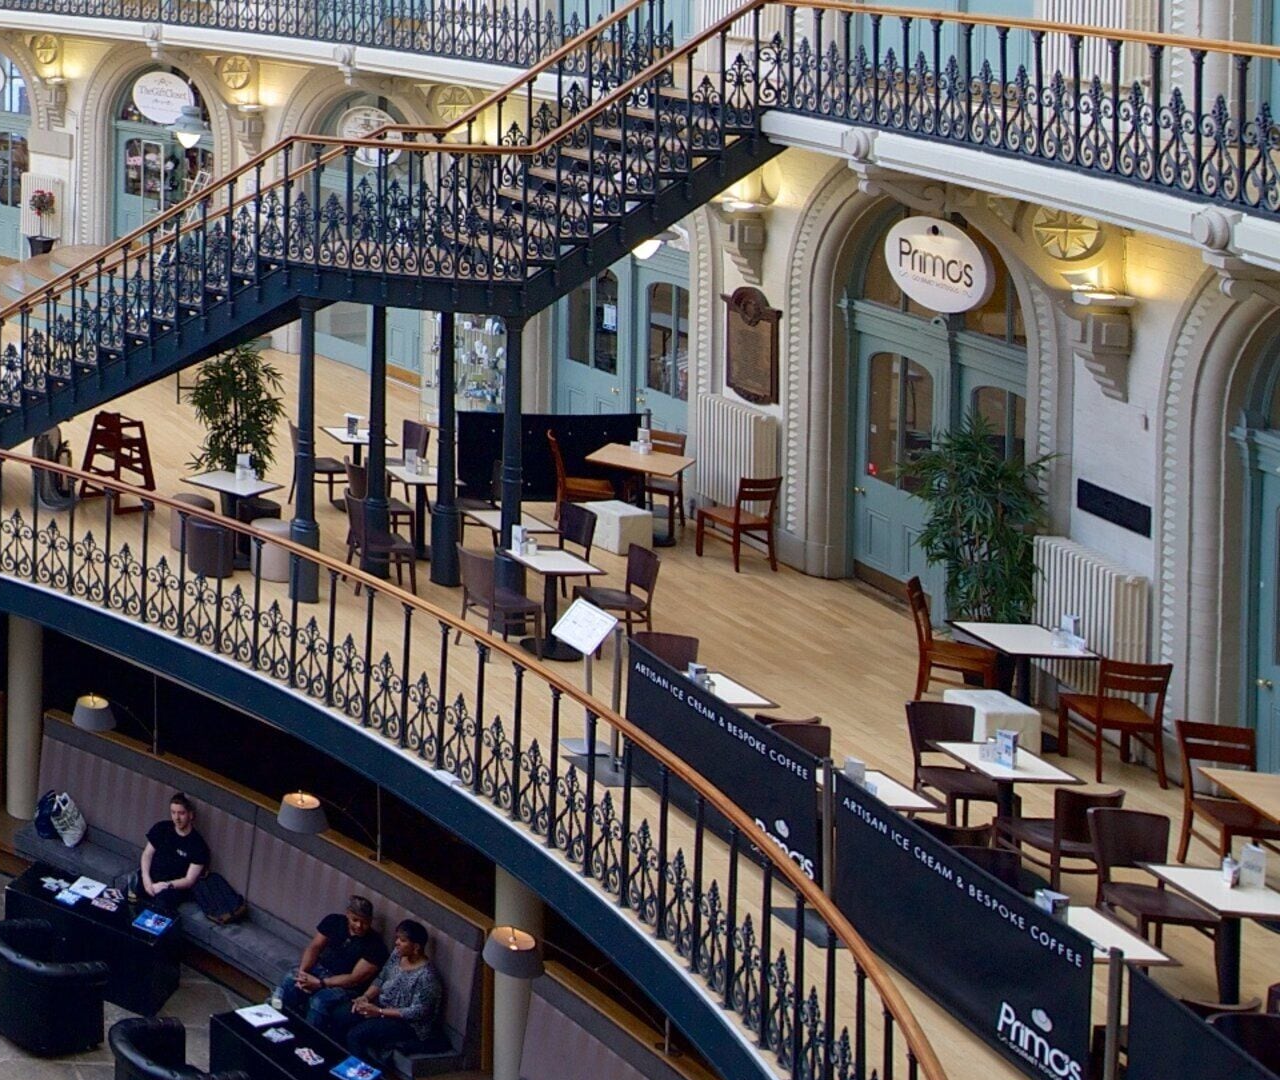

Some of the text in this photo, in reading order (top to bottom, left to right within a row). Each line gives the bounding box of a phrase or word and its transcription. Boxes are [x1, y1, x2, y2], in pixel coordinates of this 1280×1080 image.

[635, 661, 809, 780] ARTISAN ICE CREAM & BESPOKE COFFEE
[842, 796, 1082, 968] ARTISAN ICE CREAM & BESPOKE COFFEE
